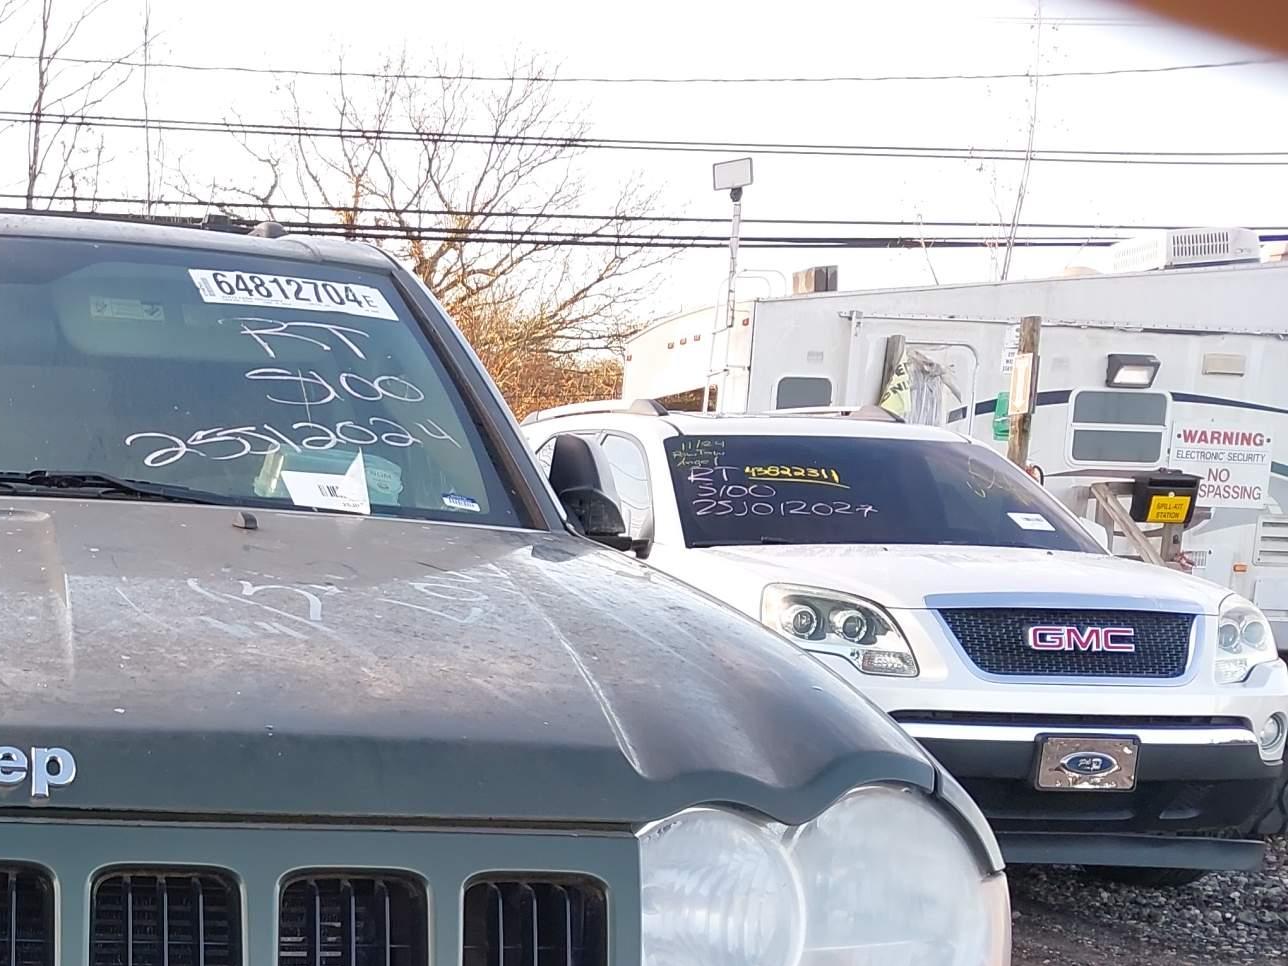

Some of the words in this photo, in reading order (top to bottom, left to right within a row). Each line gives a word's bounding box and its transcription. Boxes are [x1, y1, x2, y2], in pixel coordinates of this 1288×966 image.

[213, 272, 363, 308] 64812704
[218, 317, 370, 360] RT
[1182, 429, 1265, 447] WARNING
[1176, 449, 1224, 461] ELECTRONIC
[1227, 452, 1266, 463] SECURITY
[688, 466, 739, 483] RT
[1207, 468, 1231, 483] NO
[1198, 483, 1262, 501] SPASSING
[1028, 626, 1135, 652] GMC
